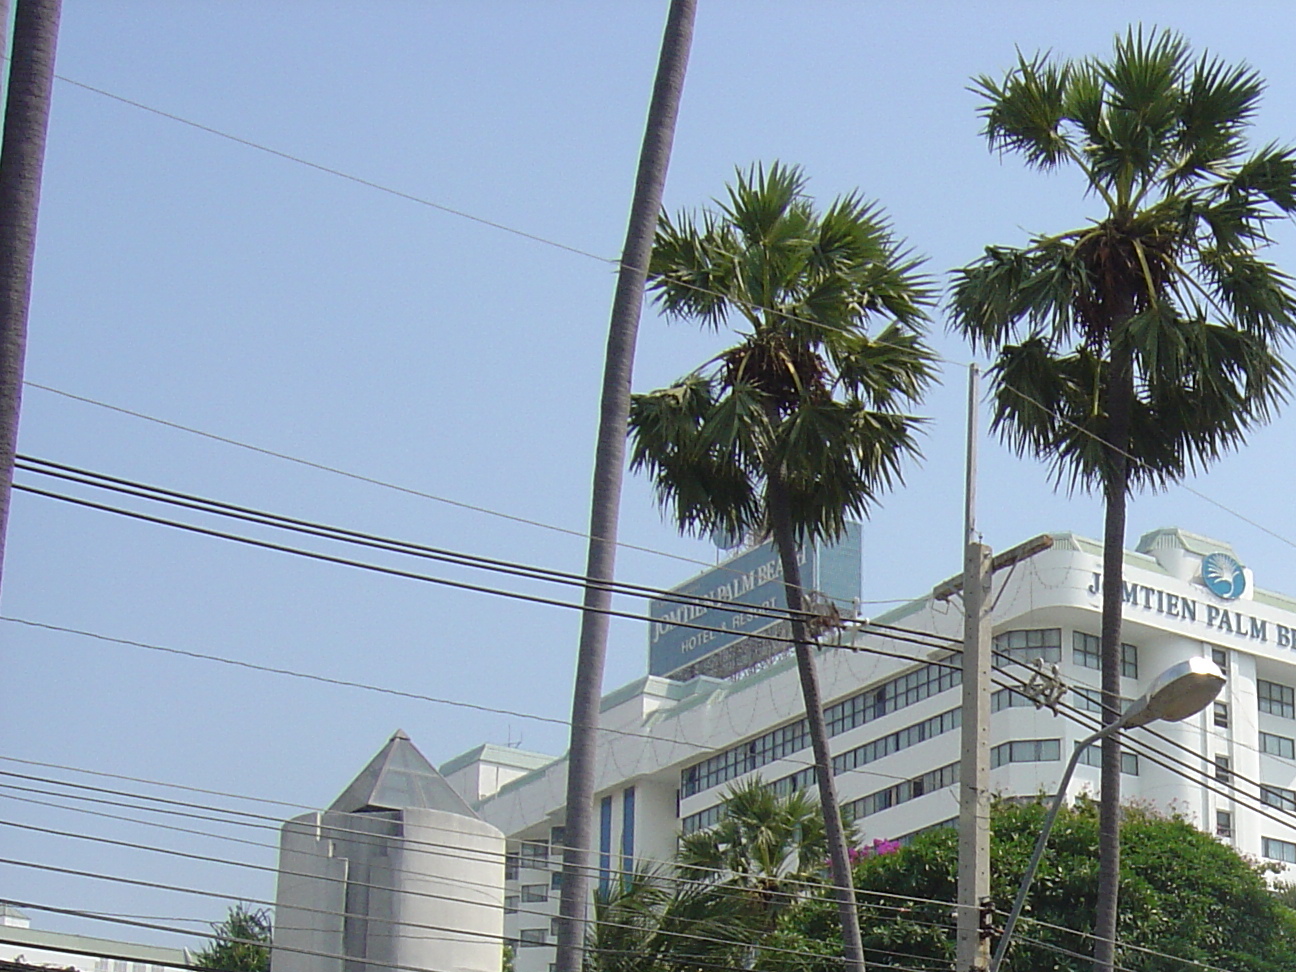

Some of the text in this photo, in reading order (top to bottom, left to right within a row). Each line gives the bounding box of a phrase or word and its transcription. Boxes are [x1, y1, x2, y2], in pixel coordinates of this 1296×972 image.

[717, 570, 755, 607] PALM
[756, 543, 808, 585] BEAH
[1088, 572, 1197, 622] JMTIEN
[1206, 604, 1268, 642] PALM
[681, 629, 717, 653] HOTEL
